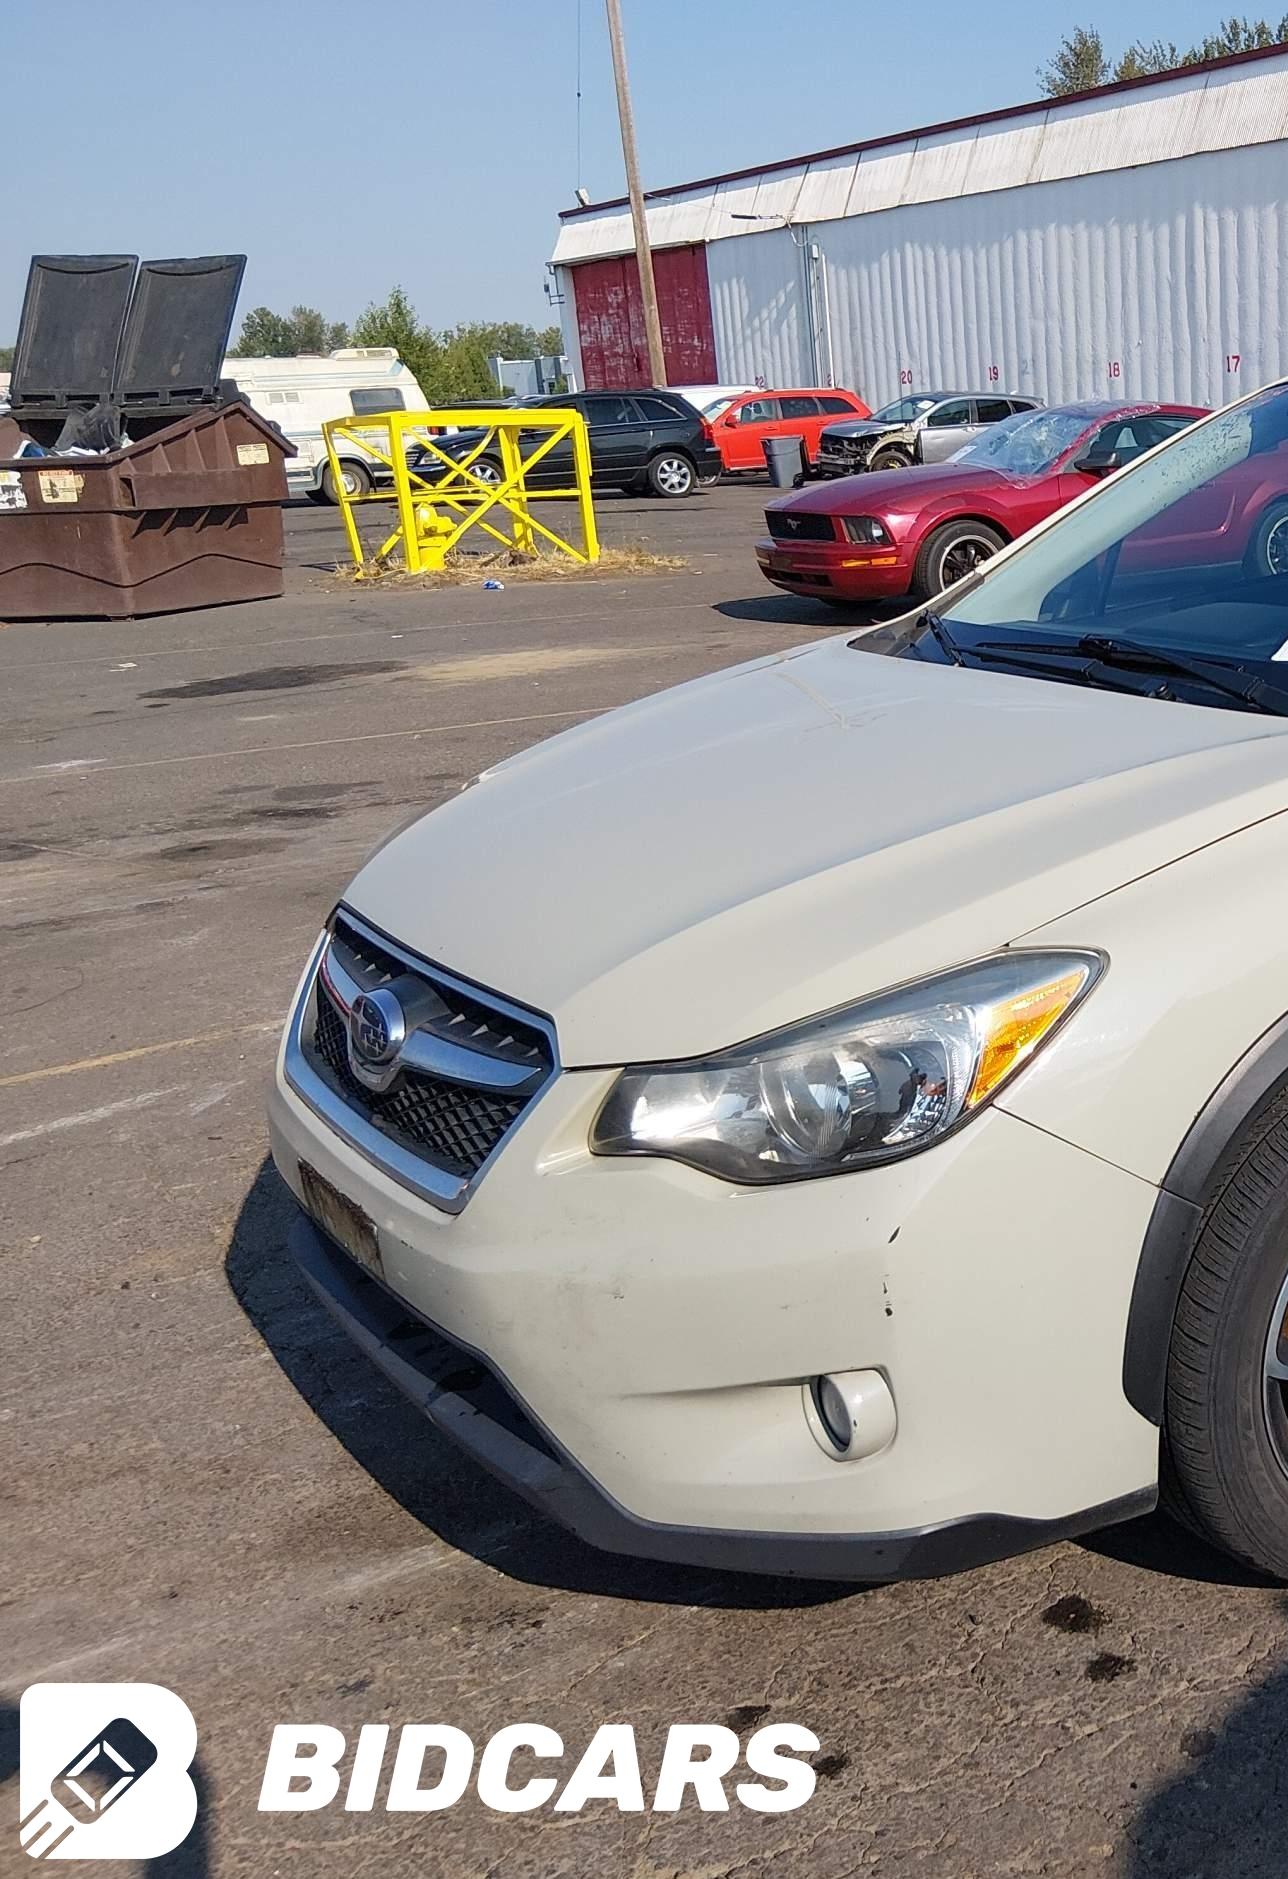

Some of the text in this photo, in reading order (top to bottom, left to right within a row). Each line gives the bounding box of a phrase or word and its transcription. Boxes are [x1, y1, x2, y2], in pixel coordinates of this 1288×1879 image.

[1108, 362, 1120, 378] 18
[1226, 355, 1240, 373] 17
[900, 370, 913, 385] 20
[988, 366, 999, 381] 19
